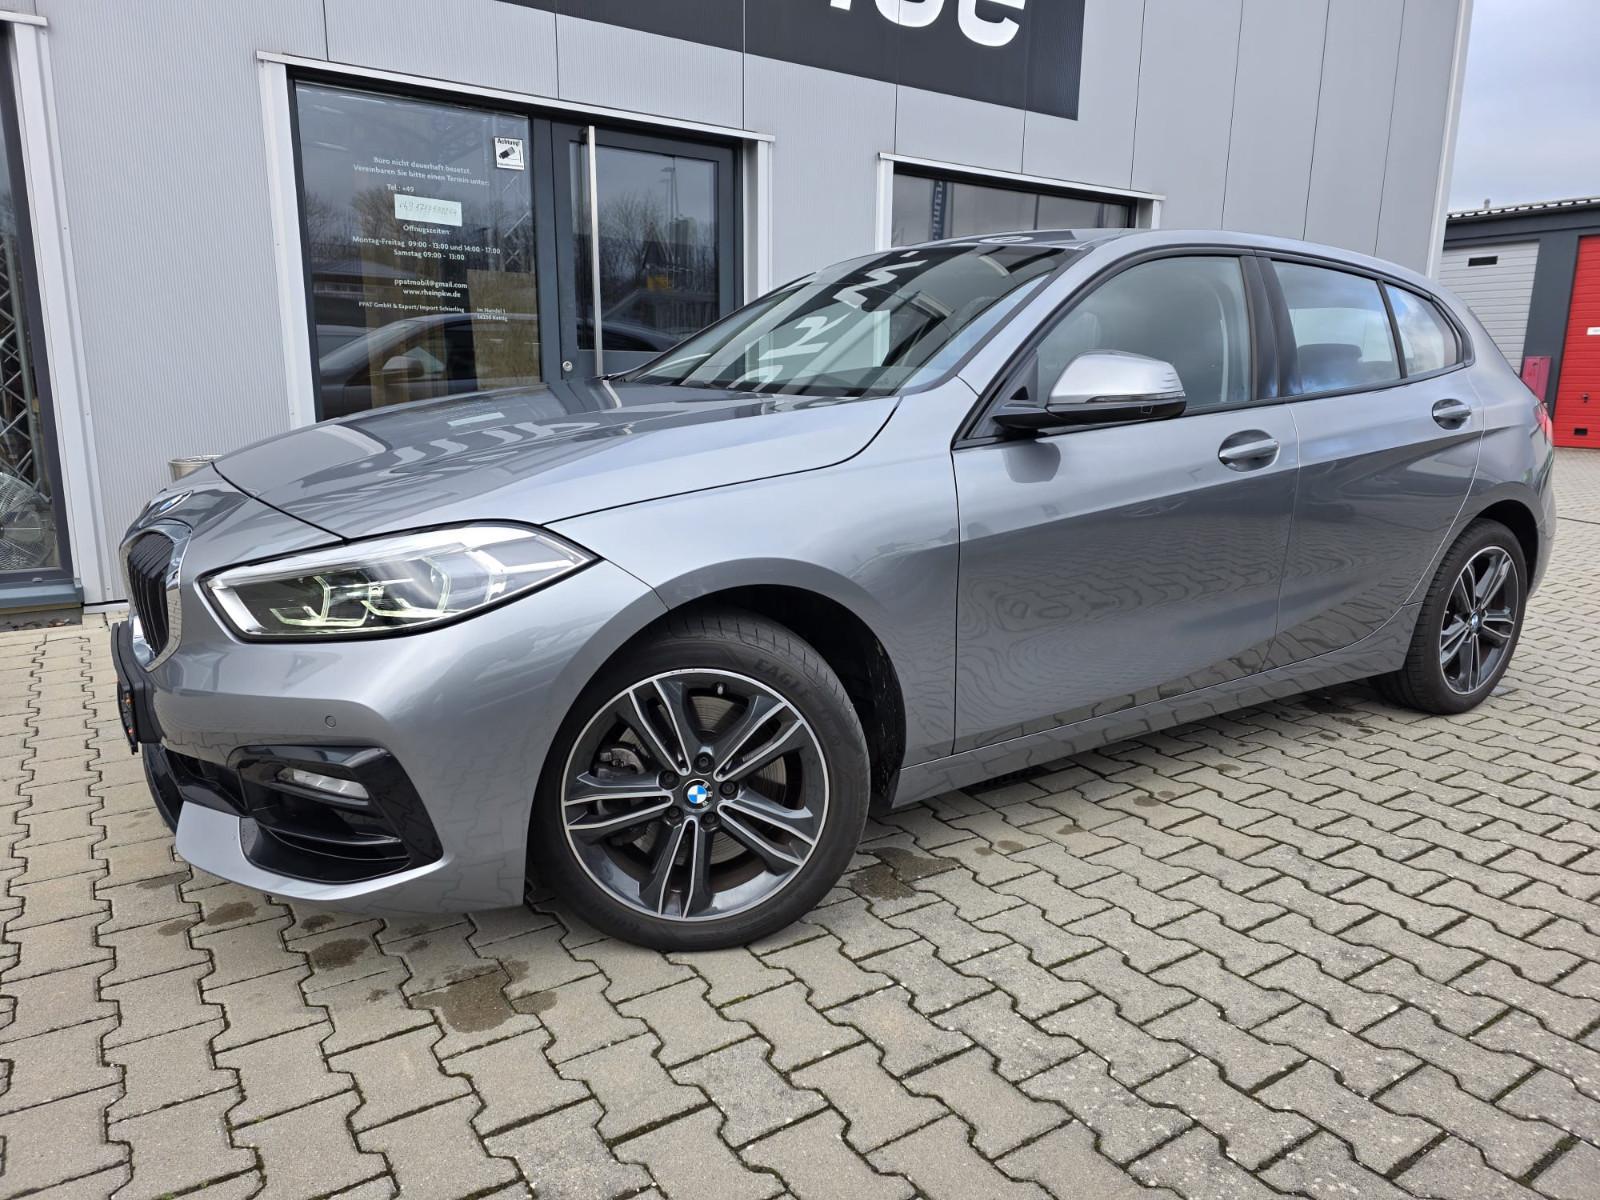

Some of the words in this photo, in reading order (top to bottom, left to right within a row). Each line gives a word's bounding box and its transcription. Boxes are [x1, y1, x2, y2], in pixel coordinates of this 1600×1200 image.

[353, 164, 396, 175] Vereinbaren
[408, 170, 426, 179] bitte
[427, 173, 446, 181] einen
[447, 175, 469, 184] Termin
[391, 159, 409, 167] nicht
[410, 161, 444, 172] dauerhaft
[445, 165, 471, 175] besetzt.
[352, 235, 405, 248] Montag-Freitag
[408, 240, 427, 248] 09:00
[433, 241, 449, 250] 13:00
[450, 243, 463, 251] und
[464, 244, 480, 253] 14:00
[485, 246, 501, 255] 17:00
[394, 249, 422, 259] Samstag
[423, 250, 442, 259] 09:00
[449, 252, 465, 261] 13:00
[394, 278, 468, 290] ppatmobil@gmail.com
